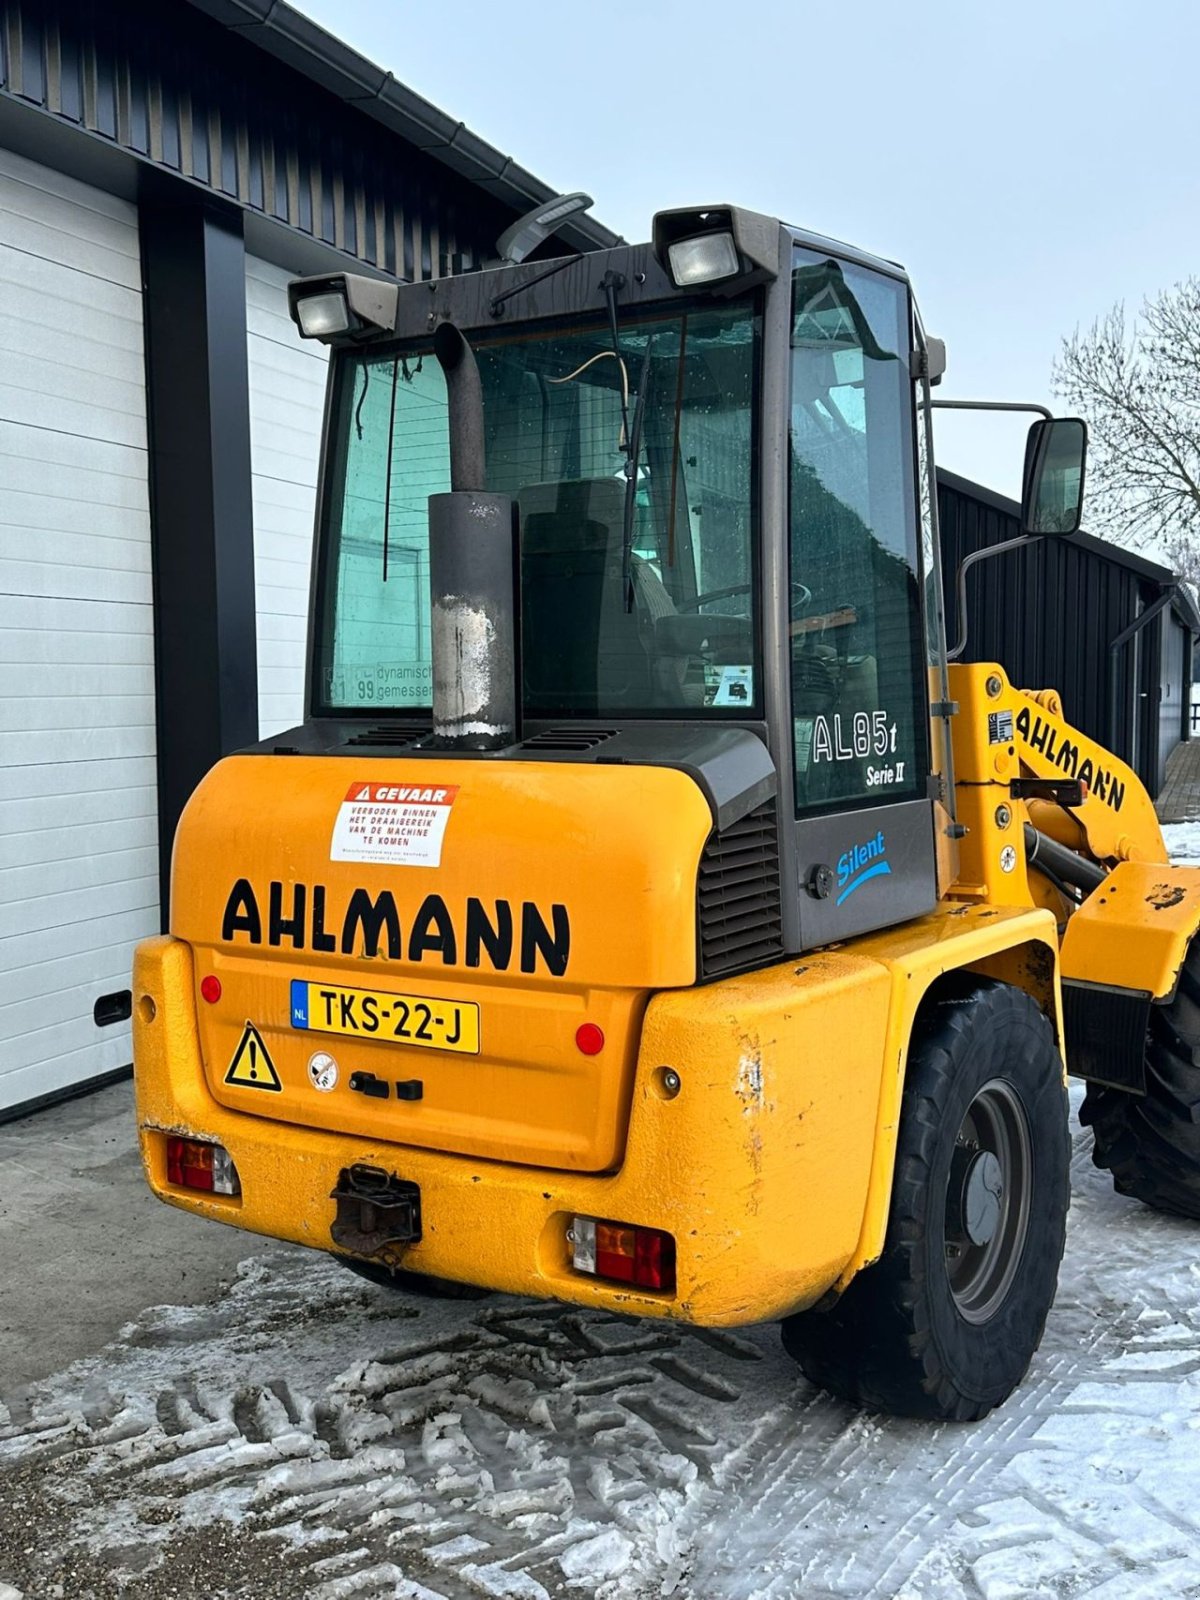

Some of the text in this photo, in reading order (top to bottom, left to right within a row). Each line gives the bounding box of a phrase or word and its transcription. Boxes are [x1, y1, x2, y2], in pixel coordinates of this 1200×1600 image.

[358, 680, 374, 700] 99
[1015, 707, 1125, 813] AHLMANN
[866, 763, 894, 786] Serie
[375, 786, 448, 803] GEVAAR
[351, 806, 438, 818] VERBODEN BINNEN
[349, 816, 433, 827] HET DRAAIBEREIK
[349, 826, 429, 837] VAN DE MACHINE
[363, 836, 410, 847] TE KOMEN
[836, 831, 886, 888] Silent
[221, 877, 571, 977] AHLMANN
[294, 1008, 307, 1021] NL
[320, 990, 462, 1045] TKS-22-J
